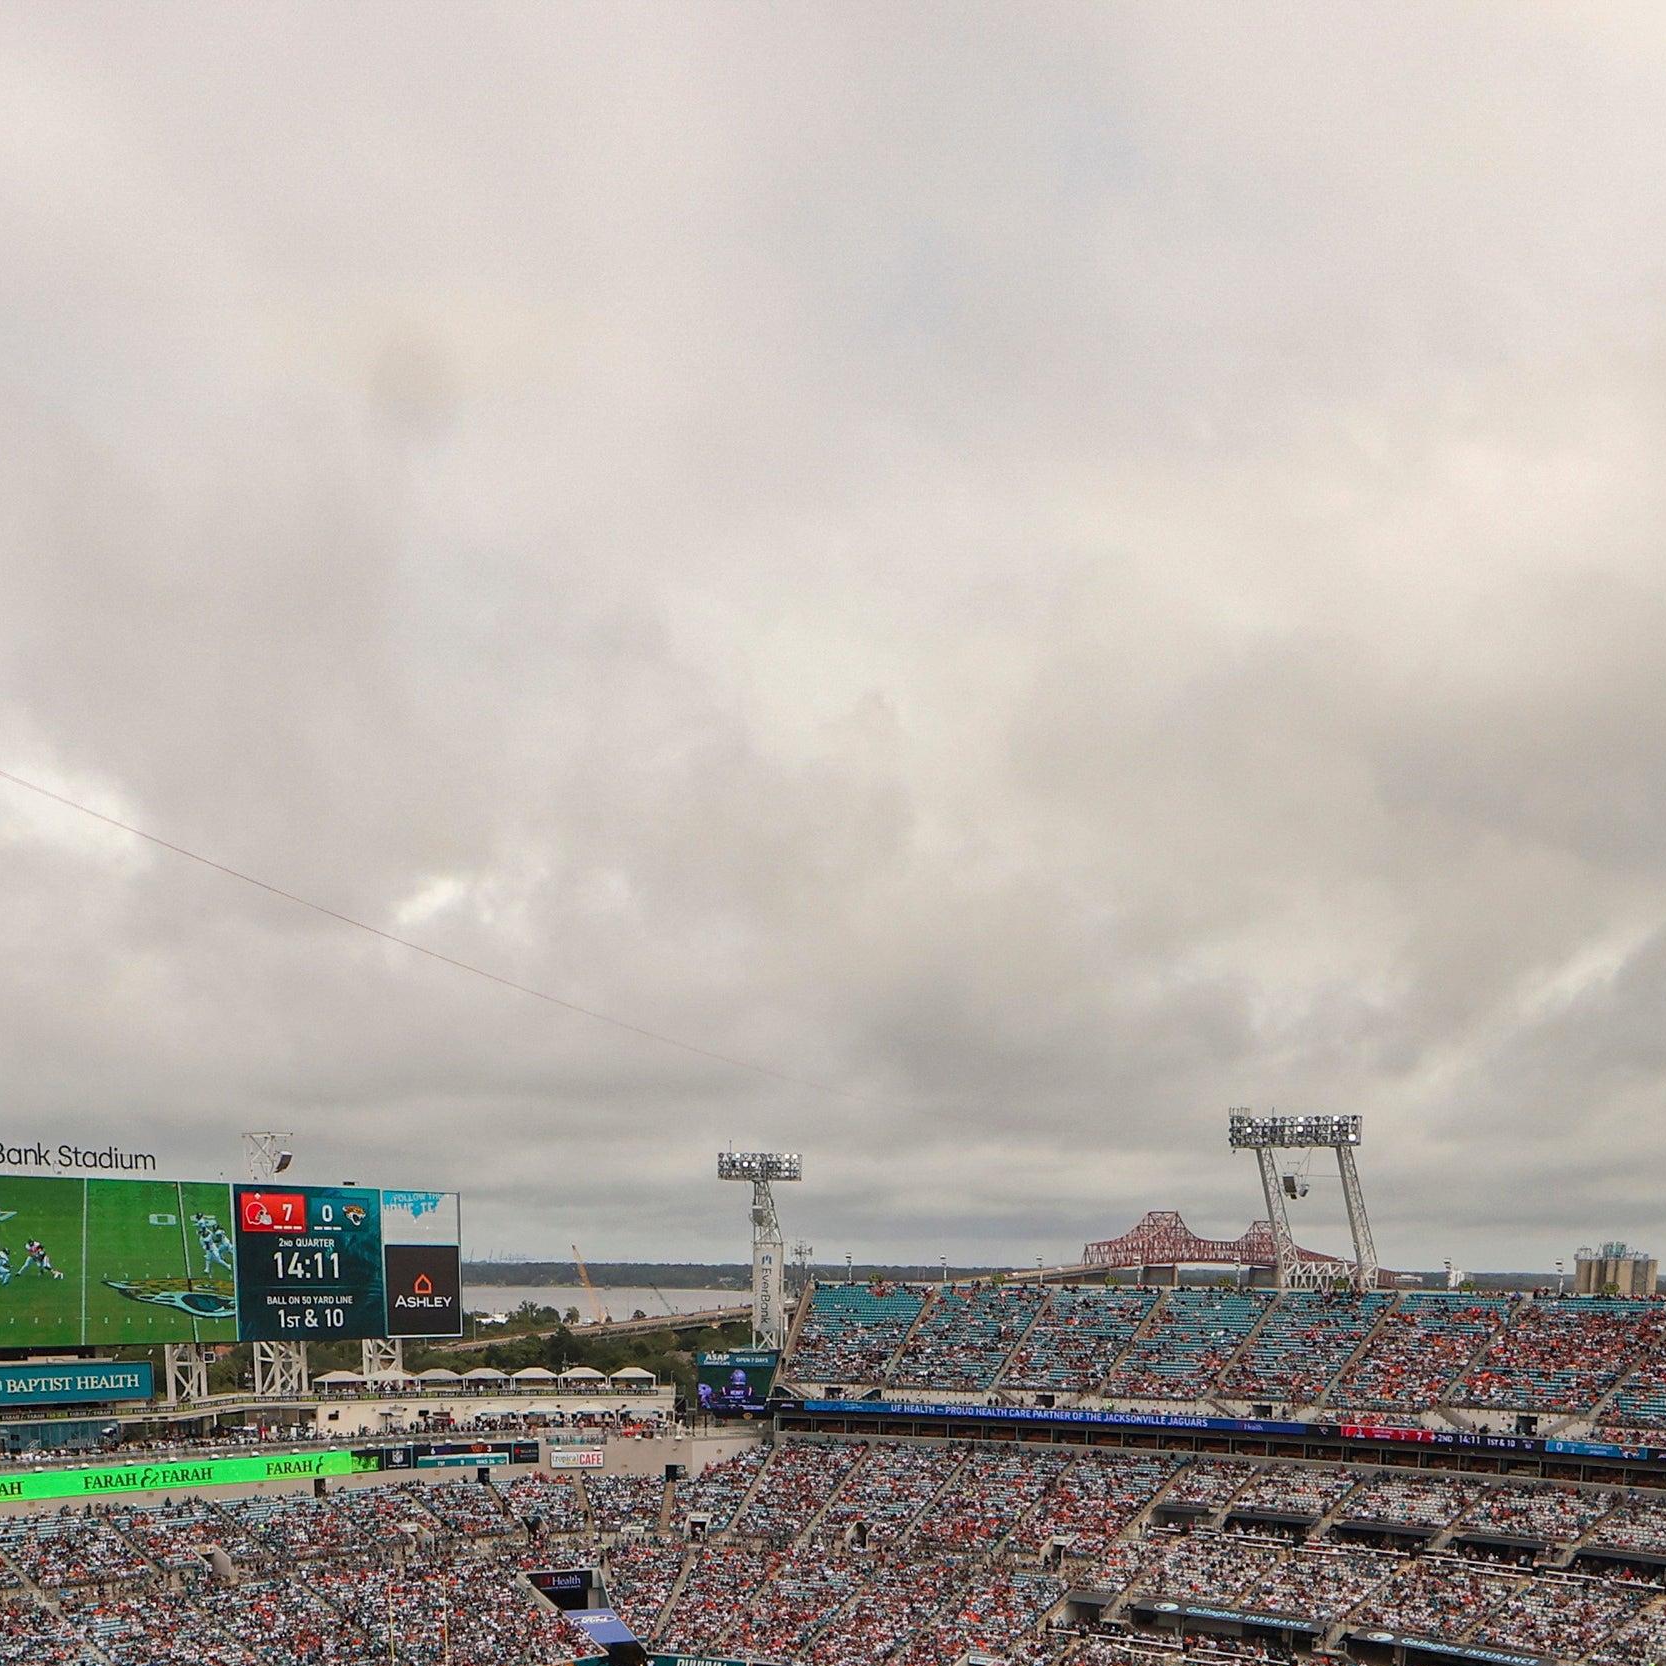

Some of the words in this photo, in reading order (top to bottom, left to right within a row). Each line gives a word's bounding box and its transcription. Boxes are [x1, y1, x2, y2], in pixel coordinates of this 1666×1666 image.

[58, 1145, 156, 1171] Stadium
[282, 1204, 293, 1221] 7
[322, 1205, 333, 1222] 0
[278, 1238, 293, 1247] 2ND
[295, 1238, 335, 1248] QUARTER
[273, 1251, 340, 1279] 14:11
[267, 1296, 287, 1305] BALL
[289, 1296, 300, 1305] ON
[301, 1296, 312, 1305] 50
[313, 1296, 334, 1304] YARD
[336, 1296, 353, 1304] LINE
[395, 1295, 452, 1308] ASHLEY
[278, 1309, 301, 1328] 1ST
[304, 1309, 319, 1328] &
[325, 1309, 344, 1328] 10
[7, 1377, 72, 1394] BAPTIST
[76, 1374, 139, 1391] HEALTH
[891, 1404, 902, 1412] UF
[904, 1405, 934, 1413] HEALTH
[946, 1407, 974, 1416] PROUD
[976, 1408, 1007, 1417] HEALTH
[1009, 1409, 1031, 1418] CARE
[1033, 1410, 1070, 1420] PARTNER
[1073, 1411, 1084, 1420] OF
[1085, 1412, 1102, 1422] THE
[1104, 1413, 1166, 1426] JACKSONVILLE
[1167, 1417, 1208, 1428] JAGUARS
[1417, 1431, 1422, 1441] 7
[1438, 1435, 1453, 1443] 2ND
[1459, 1435, 1480, 1444] 14:11
[1487, 1438, 1498, 1446] 1ST
[1557, 1442, 1563, 1451] 0
[580, 1454, 601, 1465] CAFE
[266, 1461, 312, 1475] FARAH
[84, 1473, 137, 1490] FARAH
[162, 1467, 212, 1484] FARAH
[552, 1575, 581, 1586] Health
[1186, 1607, 1241, 1620] Gallagher
[1245, 1614, 1312, 1629] INSURANCE
[1402, 1637, 1461, 1653] Gallagher
[1465, 1646, 1539, 1666] INSURANCE
